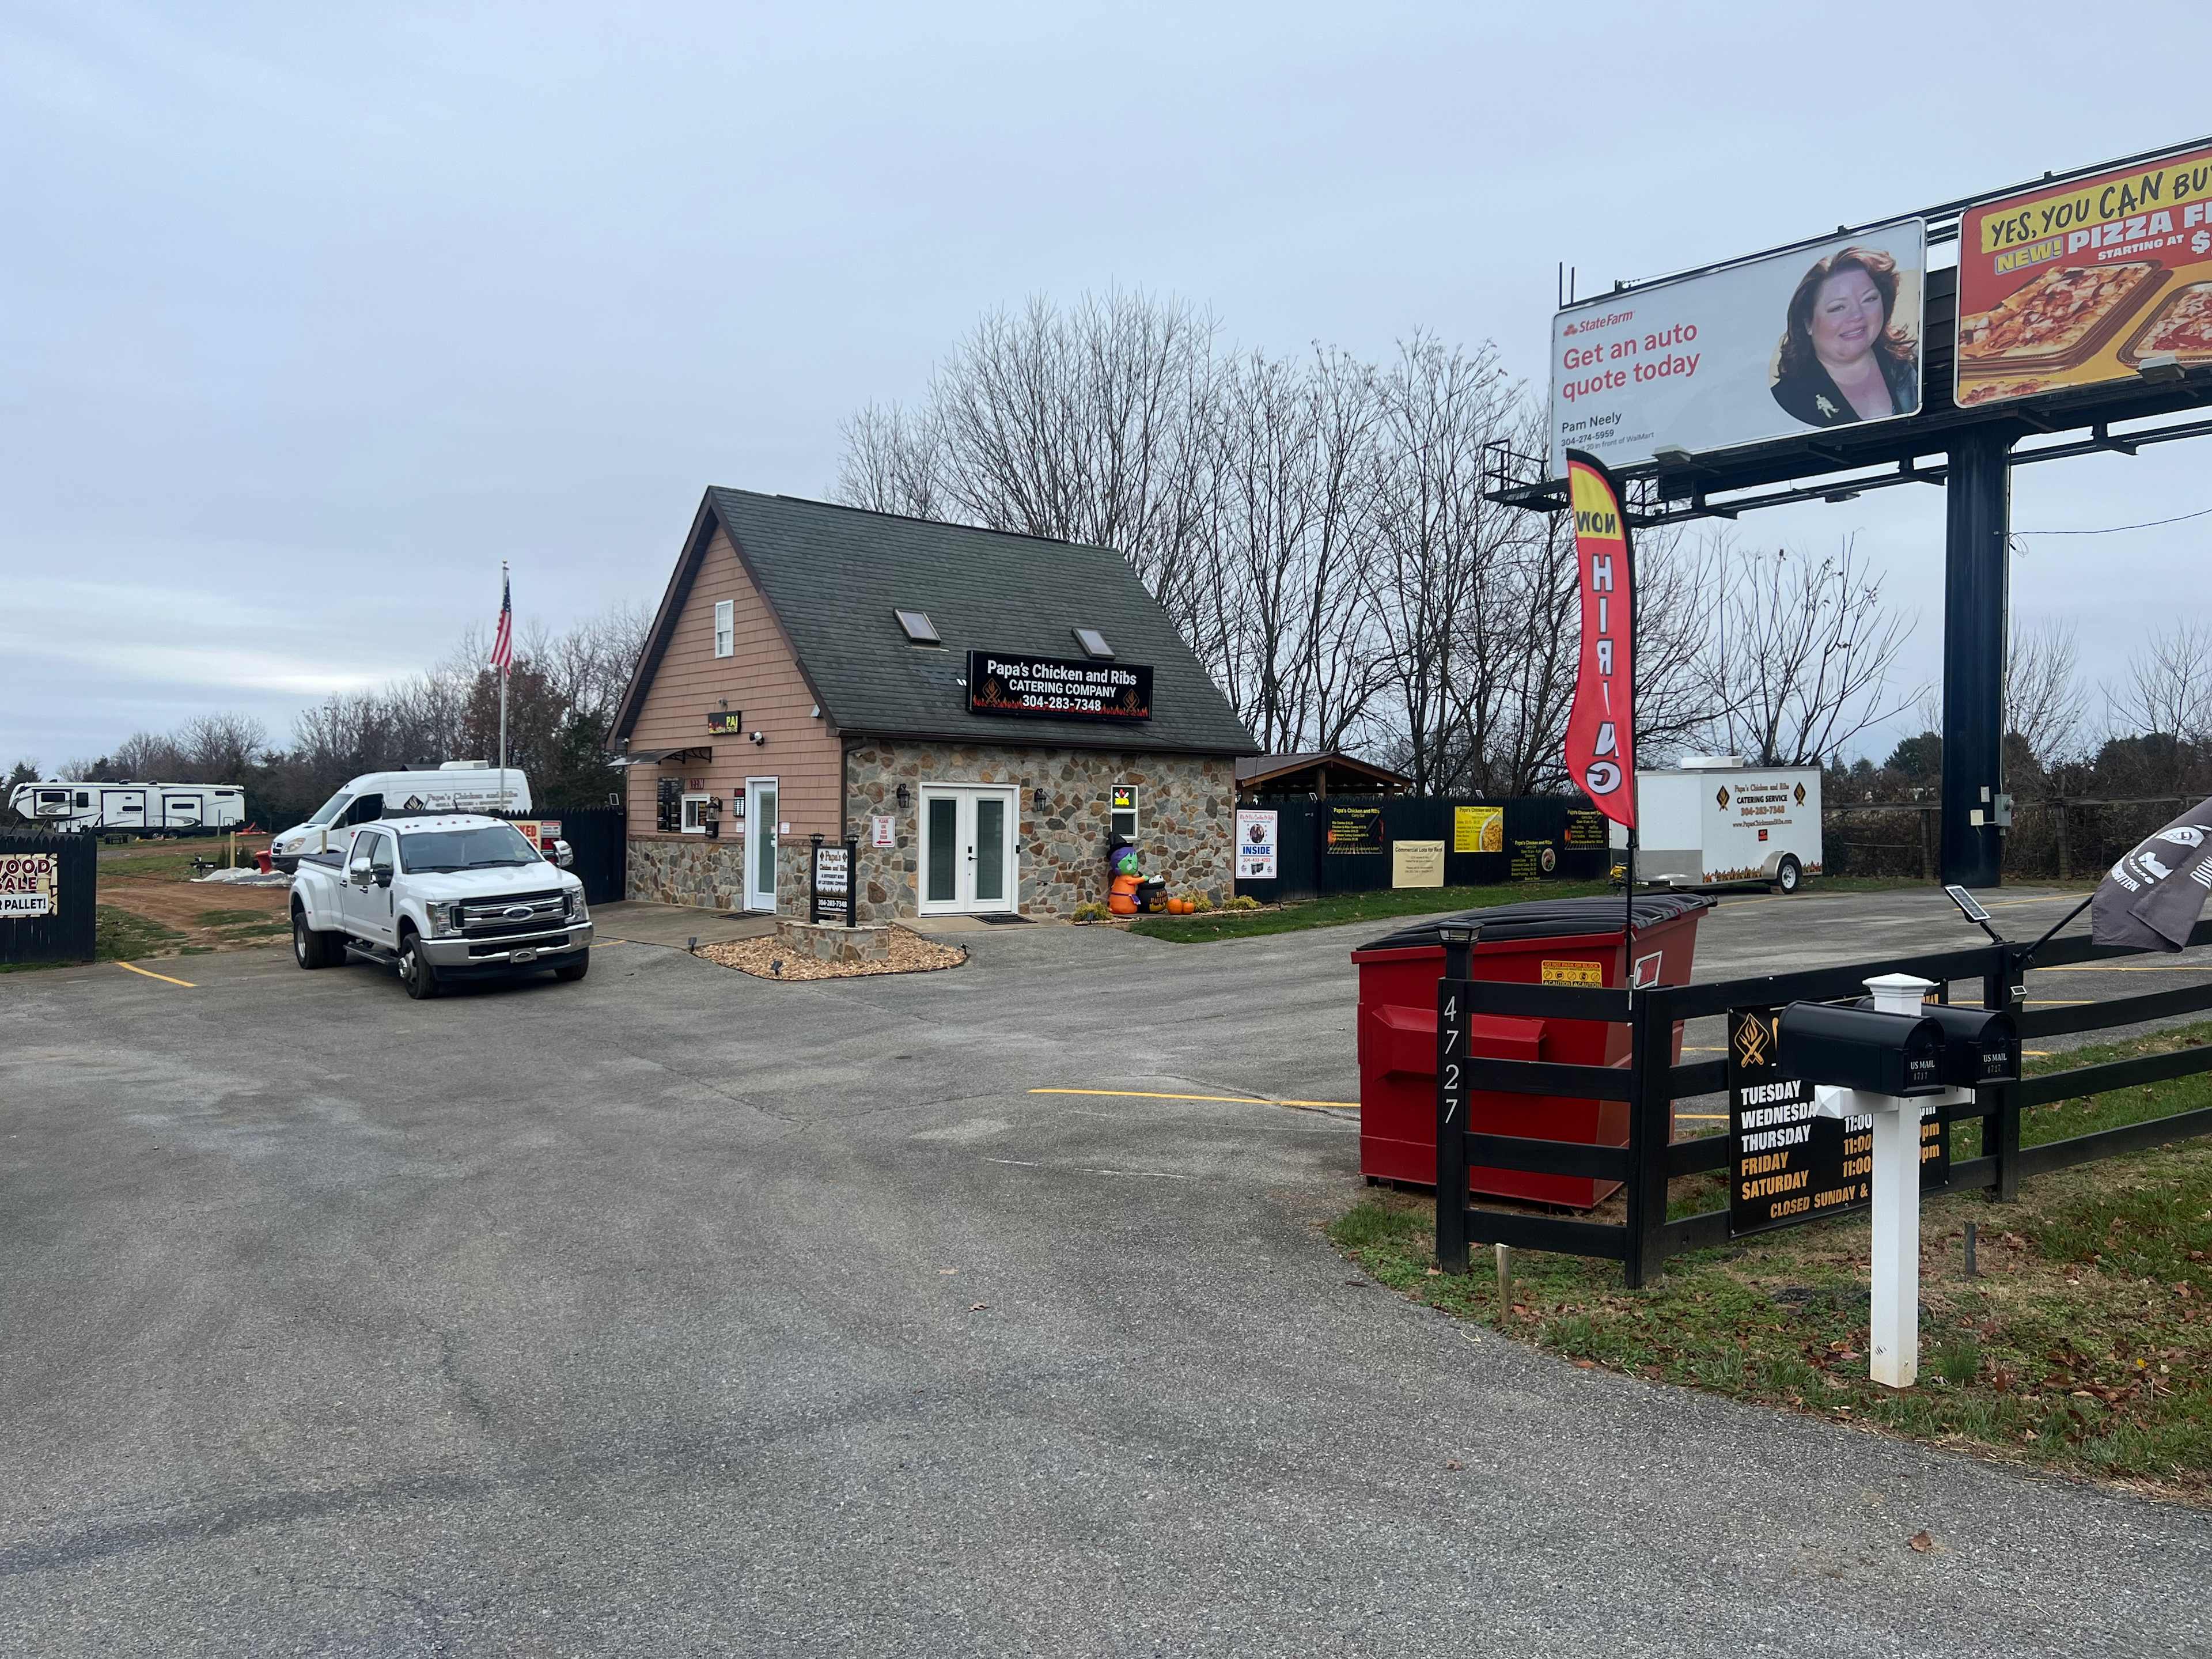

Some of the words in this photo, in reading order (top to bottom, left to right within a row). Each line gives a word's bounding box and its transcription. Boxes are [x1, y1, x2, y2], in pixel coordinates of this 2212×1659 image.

[1991, 211, 2037, 247] YES,
[2041, 198, 2090, 233] YOU
[2100, 171, 2164, 219] CAN
[2173, 165, 2212, 200] BU
[1997, 239, 2062, 272] NEW!
[2068, 211, 2173, 253] PIZZA
[2098, 238, 2163, 260] STARTING
[2166, 234, 2184, 246] AT
[1563, 343, 1603, 369] Get
[1611, 339, 1637, 359] an
[1645, 323, 1697, 351] auto
[1562, 369, 1626, 403] quote
[1633, 353, 1700, 383] today
[1562, 421, 1586, 433] Pam
[1590, 412, 1622, 428] Neely
[1561, 429, 1614, 447] 304-274-5959
[1602, 439, 1617, 448] front
[987, 660, 1029, 679] Papa's
[1032, 664, 1082, 681] Chicken
[1086, 669, 1108, 683] and
[1111, 671, 1137, 685] Ribs
[1009, 679, 1063, 694] CATERING
[1066, 684, 1116, 698] COMPANY
[1022, 695, 1101, 711] 304-283-7348
[1766, 794, 1787, 802] SERVICE
[1243, 846, 1270, 854] INSIDE
[5, 899, 46, 910] PALLET!
[1910, 1062, 1918, 1070] US
[1919, 1060, 1935, 1069] MAIL
[1983, 1054, 1991, 1062] US
[1992, 1053, 2007, 1062] MAIL
[1741, 1080, 1801, 1105] TUESDAY
[1741, 1101, 1816, 1129] WEDNESDA
[1741, 1124, 1811, 1153] THURSDAY
[1844, 1113, 1872, 1133] 11:00
[1741, 1152, 1789, 1176] FRIDAY
[1843, 1134, 1873, 1156] 11:00
[1742, 1170, 1809, 1200] SATURDAY
[1843, 1156, 1873, 1177] 11:00
[1770, 1196, 1810, 1219] CLOSED
[1814, 1185, 1855, 1208] SUNDAY
[1859, 1183, 1868, 1198] &
